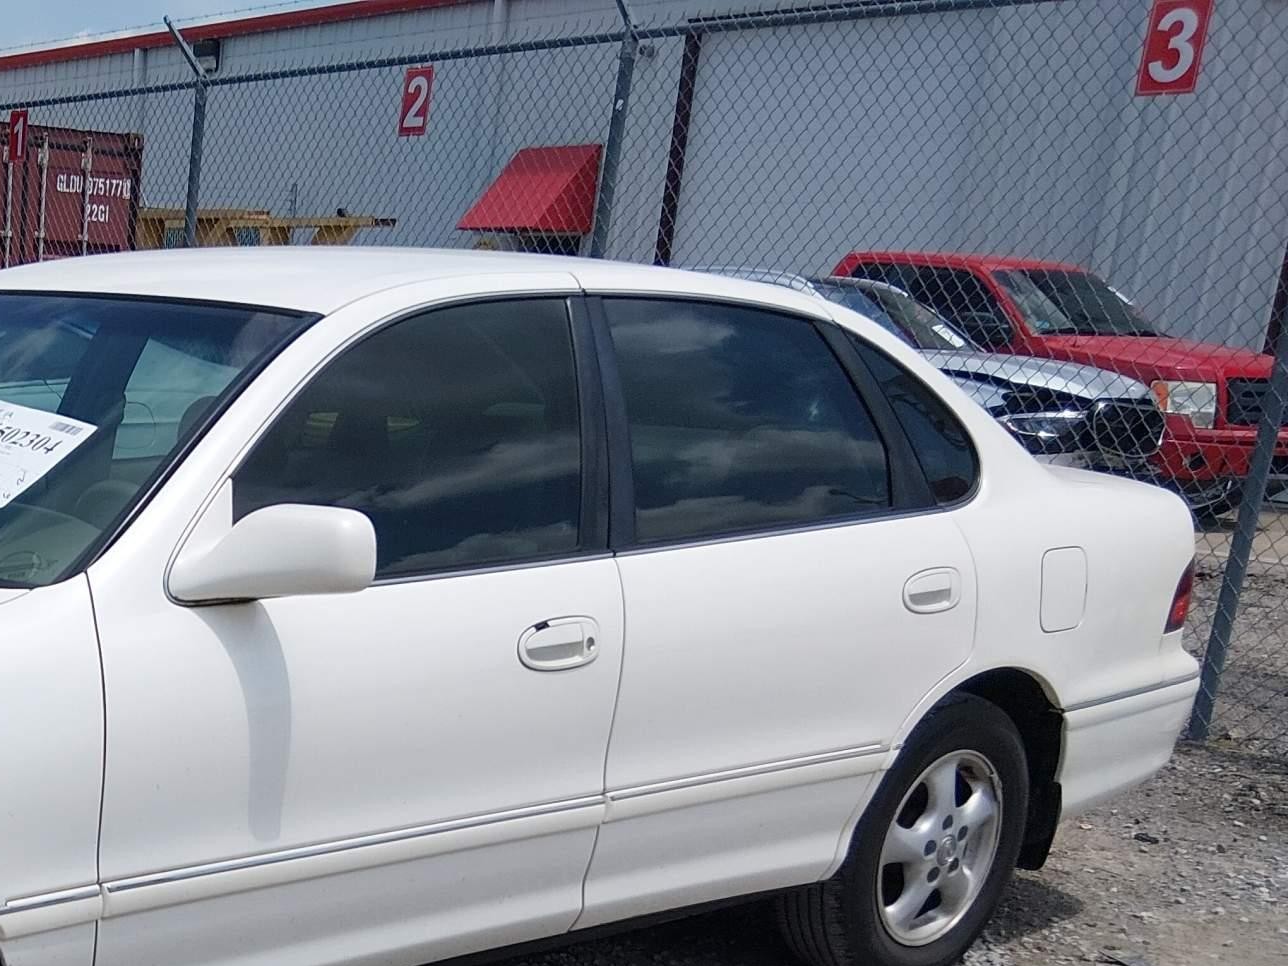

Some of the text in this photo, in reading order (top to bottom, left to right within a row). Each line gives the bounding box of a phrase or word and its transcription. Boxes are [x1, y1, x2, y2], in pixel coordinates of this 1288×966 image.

[1148, 7, 1198, 84] 3
[402, 75, 429, 128] 2
[13, 116, 25, 157] 1
[56, 173, 83, 193] GLDU
